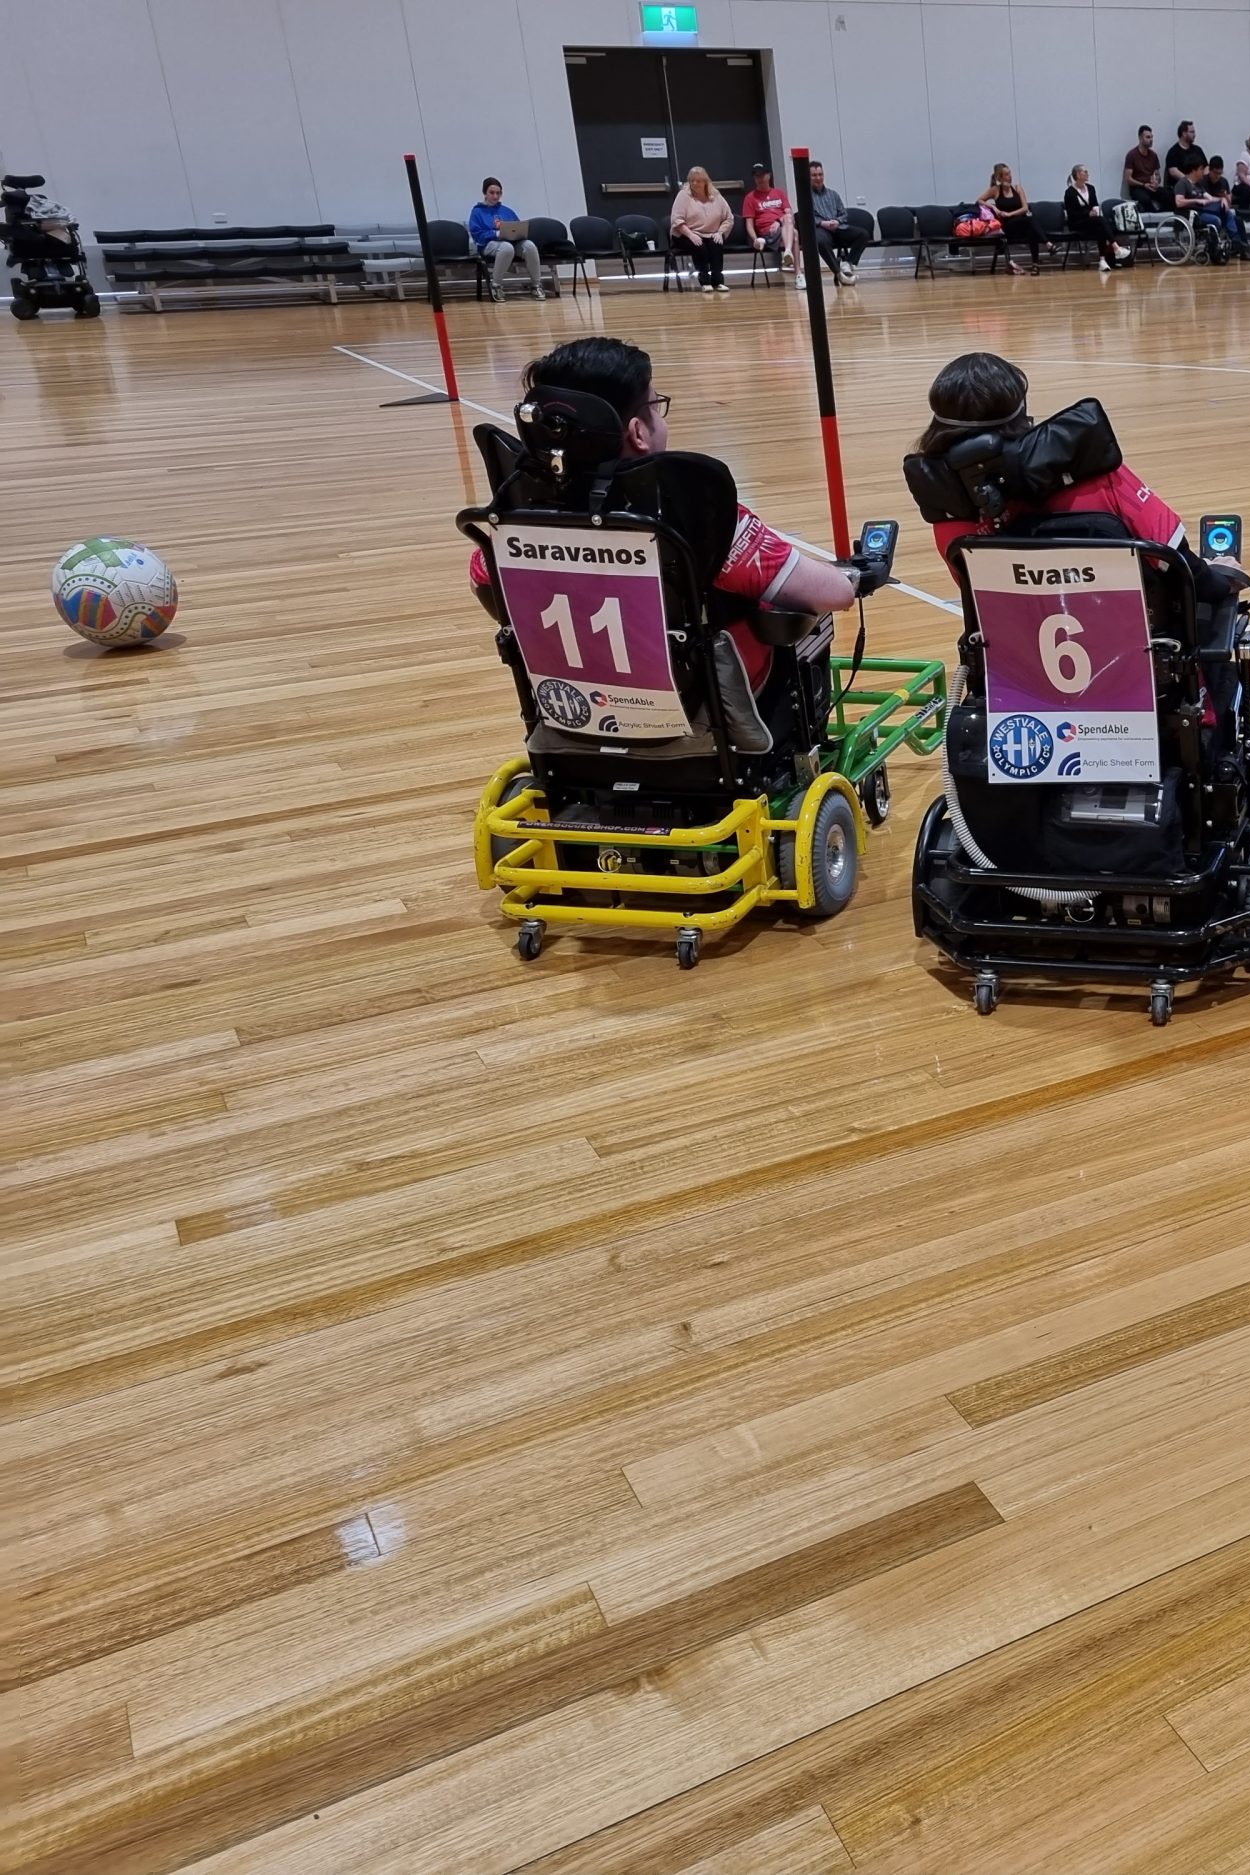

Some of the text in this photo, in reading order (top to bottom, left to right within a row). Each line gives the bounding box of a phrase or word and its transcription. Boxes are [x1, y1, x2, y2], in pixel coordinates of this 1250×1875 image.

[506, 536, 647, 566] Saravanos
[1011, 563, 1096, 586] Evans
[540, 593, 631, 675] 11
[1038, 613, 1092, 694] 6
[539, 681, 584, 702] WESTVALE
[608, 694, 655, 707] SpendAble
[543, 702, 582, 726] OLYMPIC
[618, 721, 641, 729] Acrylic
[993, 717, 1048, 742] WESTVALE
[1078, 724, 1129, 735] SpendAble
[994, 751, 1051, 777] OLYMPIC FC
[1082, 759, 1109, 767] Acrylic
